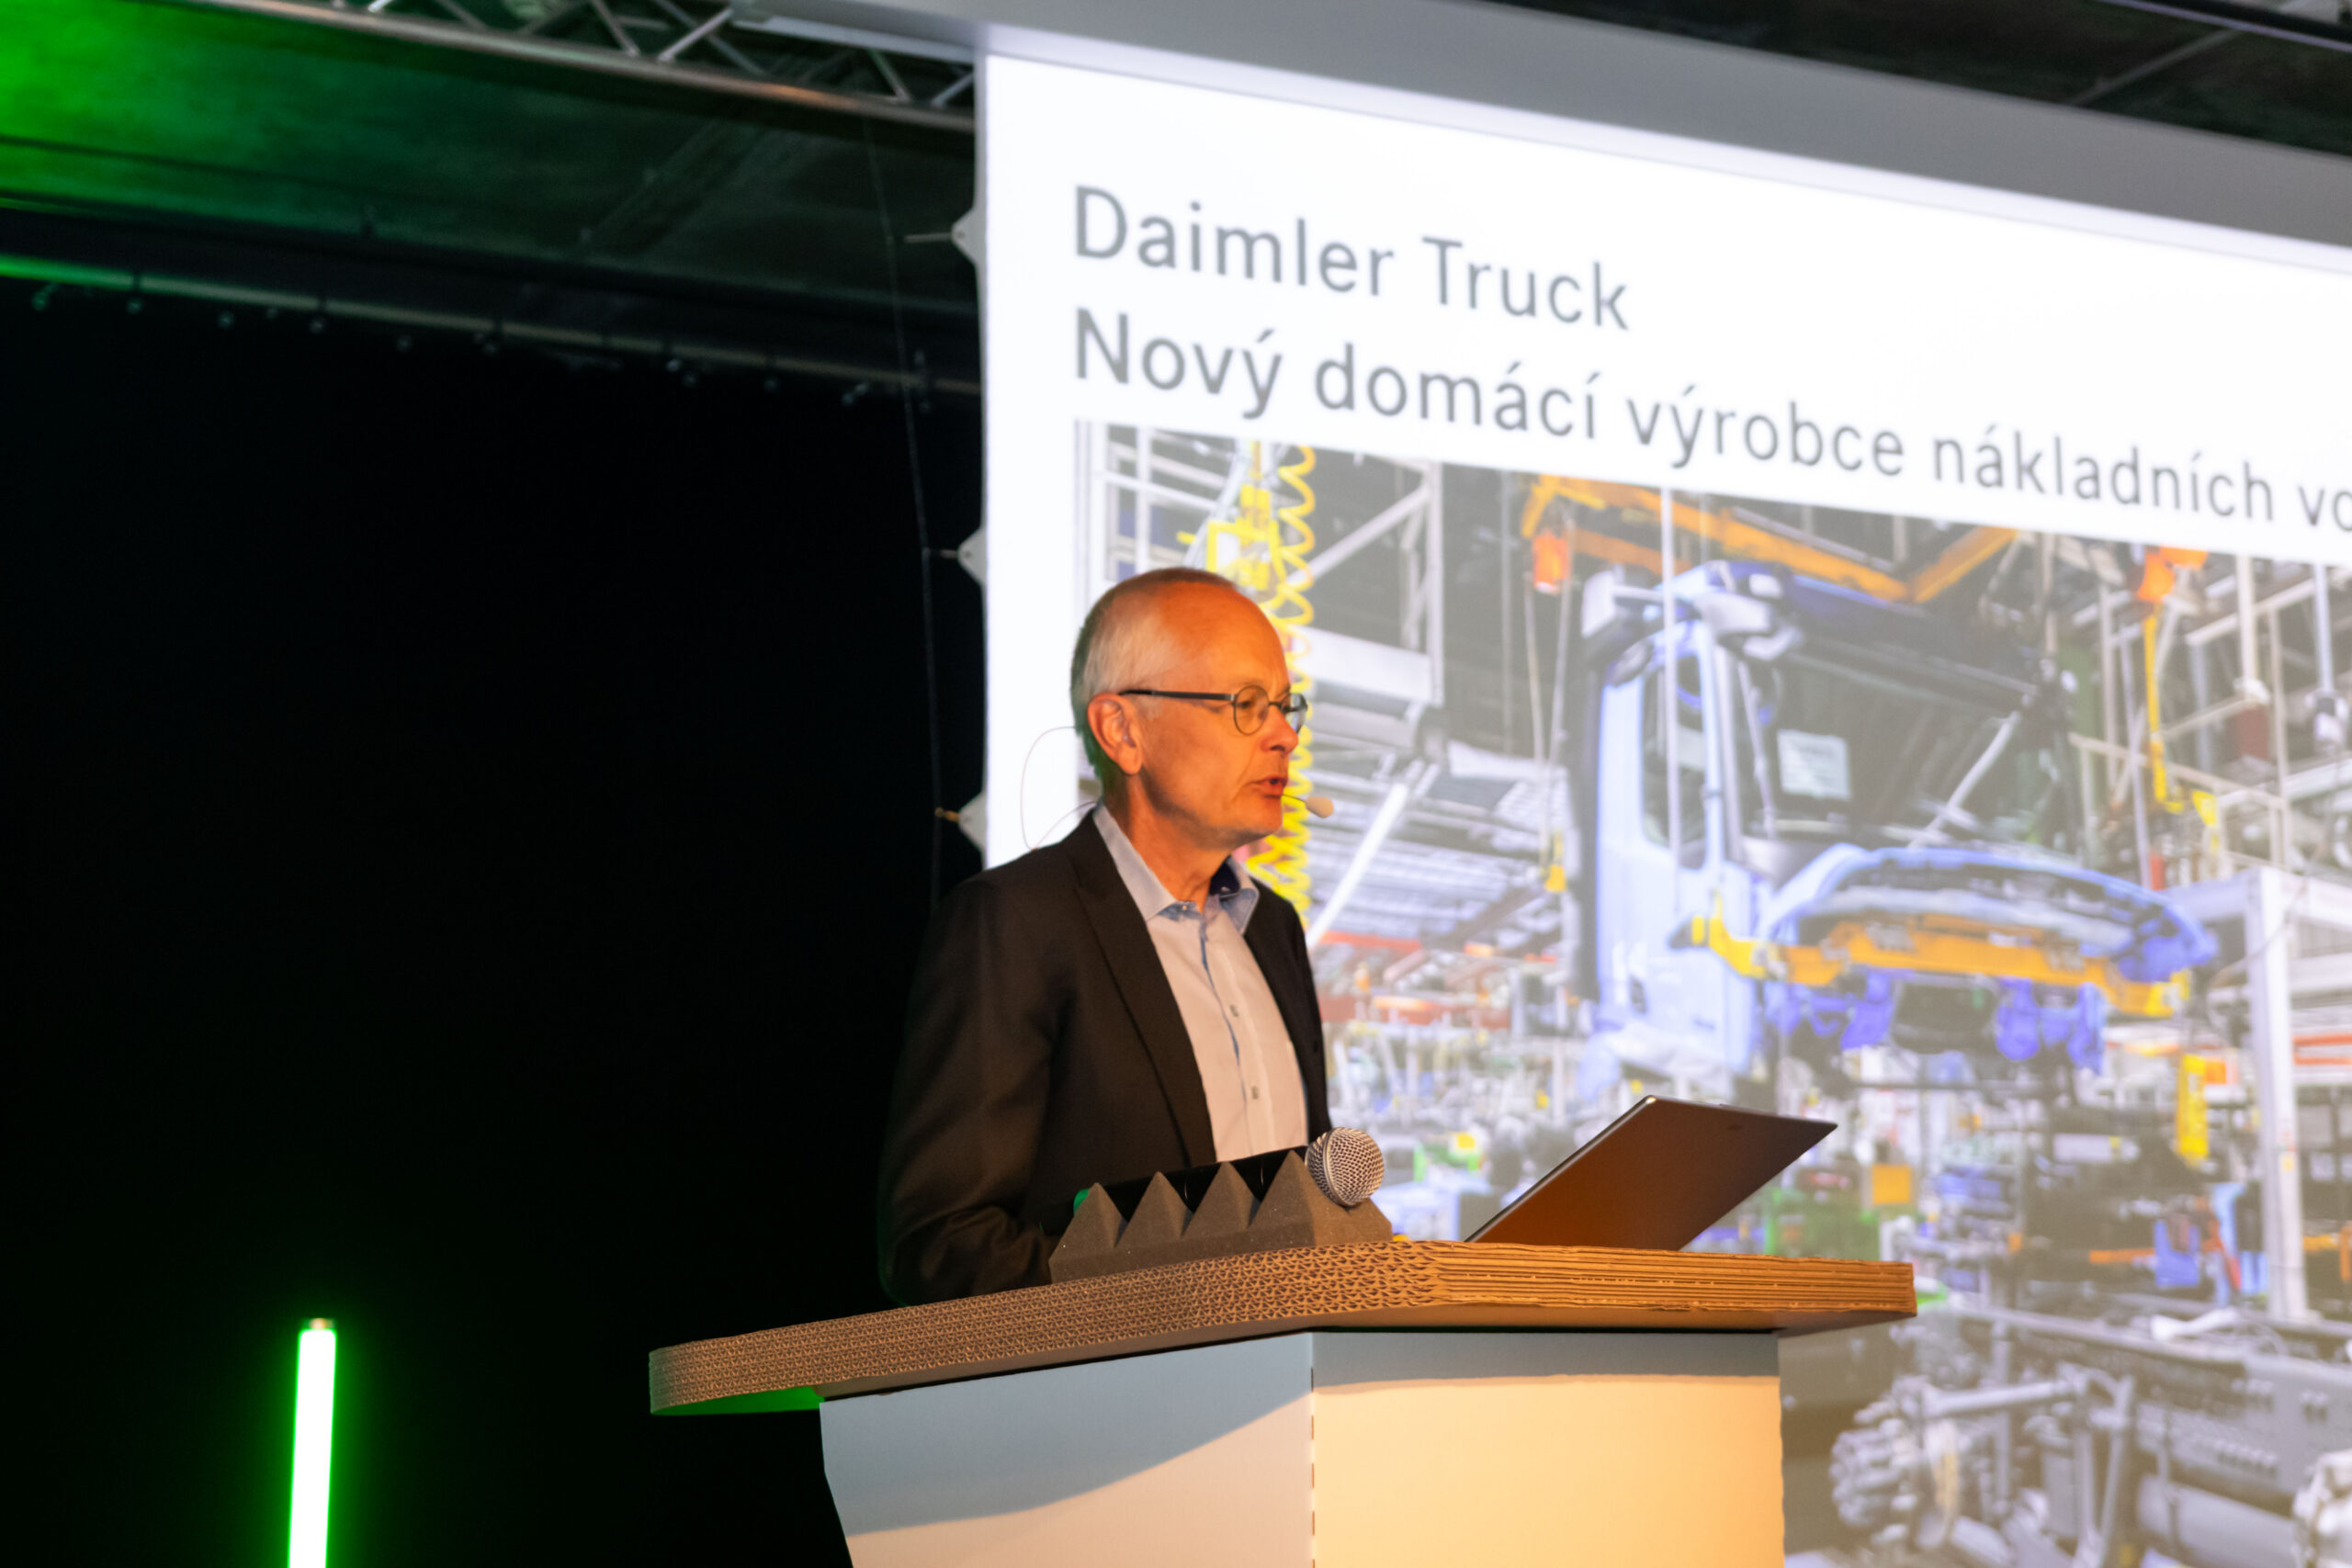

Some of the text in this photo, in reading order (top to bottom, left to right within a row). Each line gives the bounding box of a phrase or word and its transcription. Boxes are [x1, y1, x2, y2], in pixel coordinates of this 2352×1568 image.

[1075, 185, 1630, 330] Daimler Truck
[1075, 308, 1283, 420] Nový
[1315, 343, 1602, 439] domácí
[1627, 384, 1905, 476] výrobce
[1934, 424, 2274, 522] nákladních
